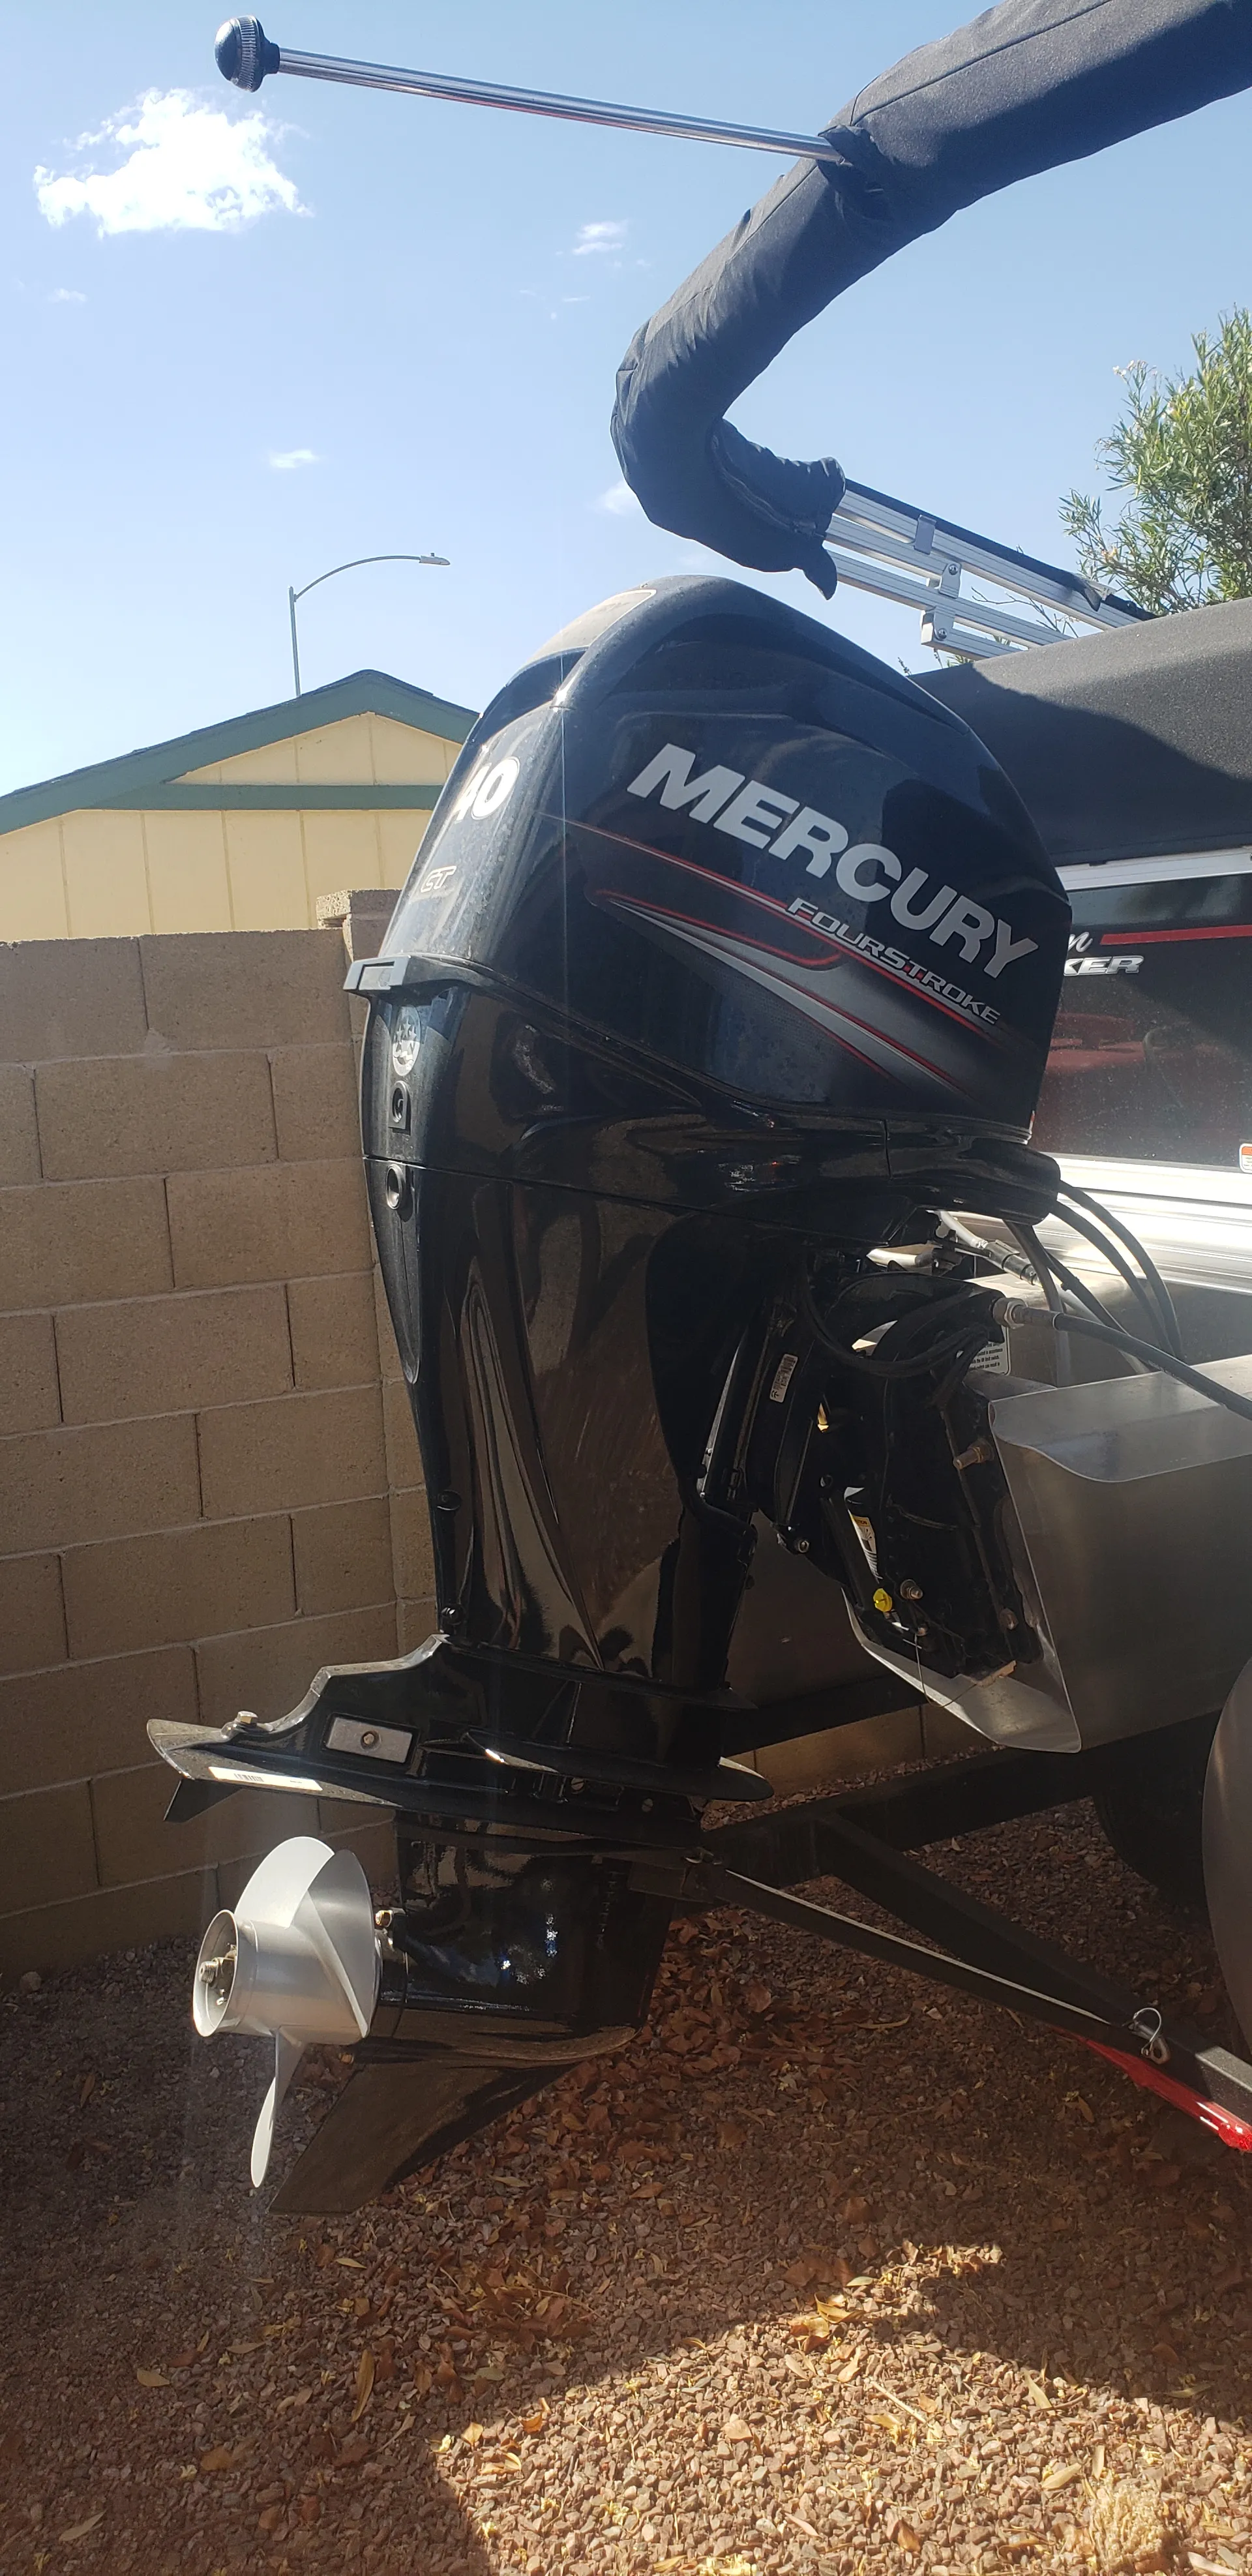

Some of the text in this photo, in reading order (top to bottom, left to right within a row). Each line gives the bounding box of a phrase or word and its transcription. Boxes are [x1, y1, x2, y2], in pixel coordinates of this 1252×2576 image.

[451, 756, 520, 823] 40
[627, 742, 1039, 979] MERCURY
[786, 897, 1001, 1025] FOURSTROKE
